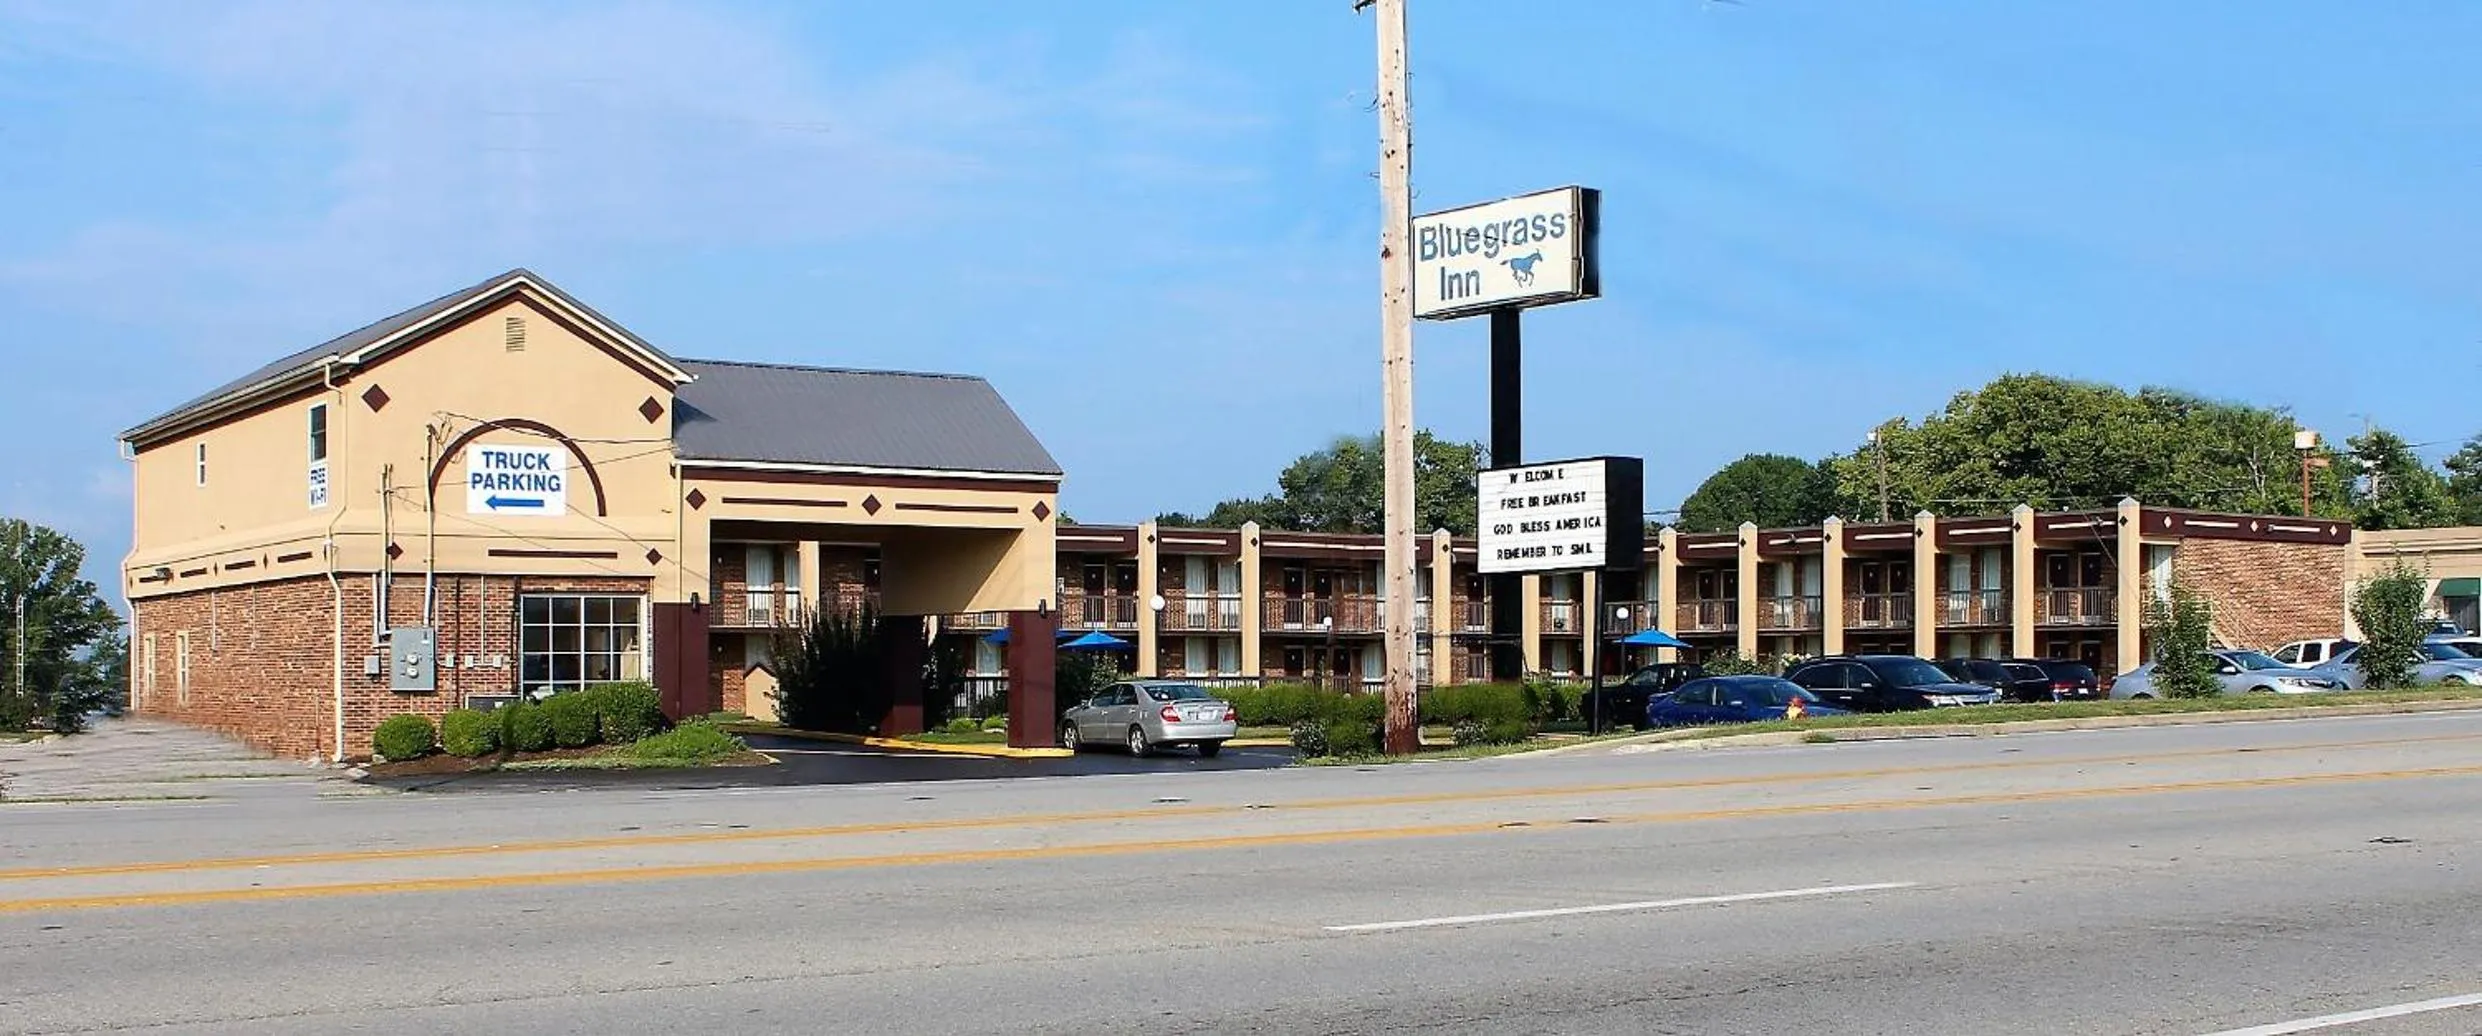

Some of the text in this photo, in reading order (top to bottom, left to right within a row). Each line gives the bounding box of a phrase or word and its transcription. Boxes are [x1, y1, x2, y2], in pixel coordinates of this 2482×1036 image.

[1419, 213, 1566, 262] Bluegrass
[1440, 266, 1480, 301] Inn
[482, 451, 550, 471] TRUCK
[471, 473, 561, 492] PARKING
[1501, 497, 1524, 510] FREE
[1494, 524, 1513, 535] GOD
[1520, 520, 1551, 533] BLESS
[1556, 516, 1601, 530] AMERICA
[1497, 546, 1546, 560] REMEMBER
[1552, 545, 1563, 556] TO
